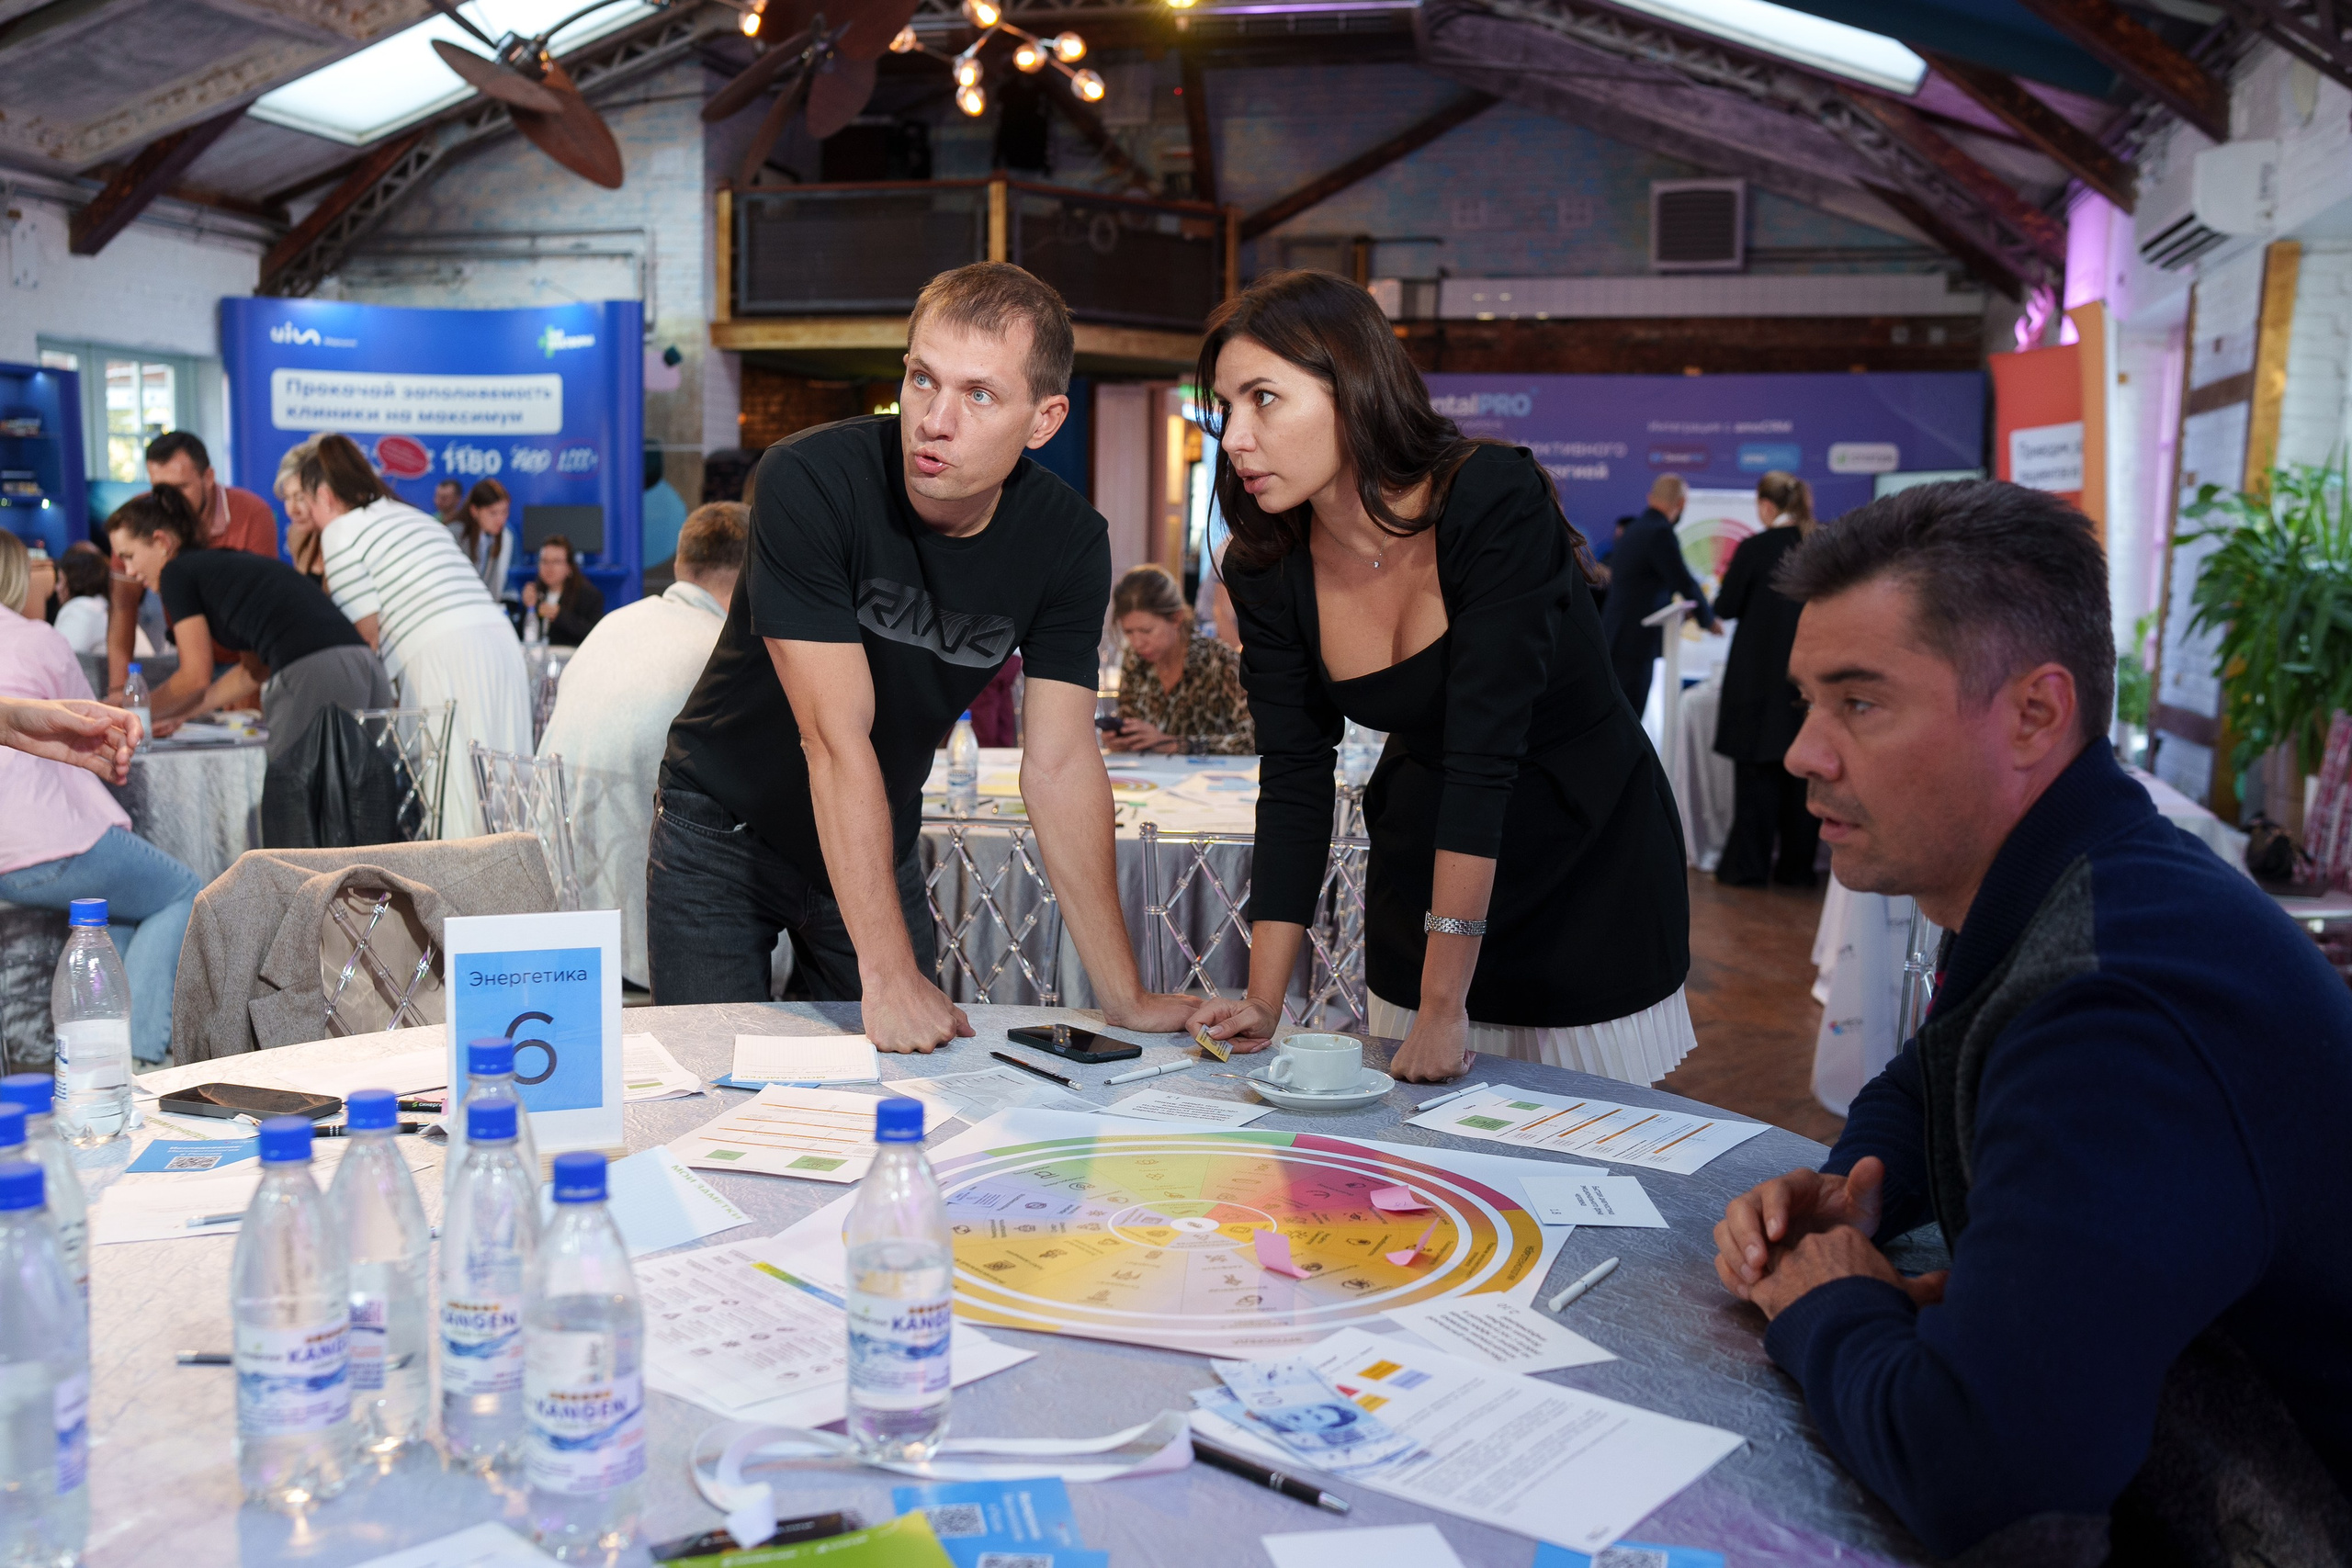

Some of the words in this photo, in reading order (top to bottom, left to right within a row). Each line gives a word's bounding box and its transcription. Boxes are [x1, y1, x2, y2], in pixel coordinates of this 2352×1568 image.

[1430, 393, 1533, 417] ntalPRO
[469, 968, 588, 987] Энергетика
[504, 1010, 558, 1086] 6
[671, 1164, 697, 1183] МОИ
[693, 1182, 743, 1220] ЗАМЕТКИ
